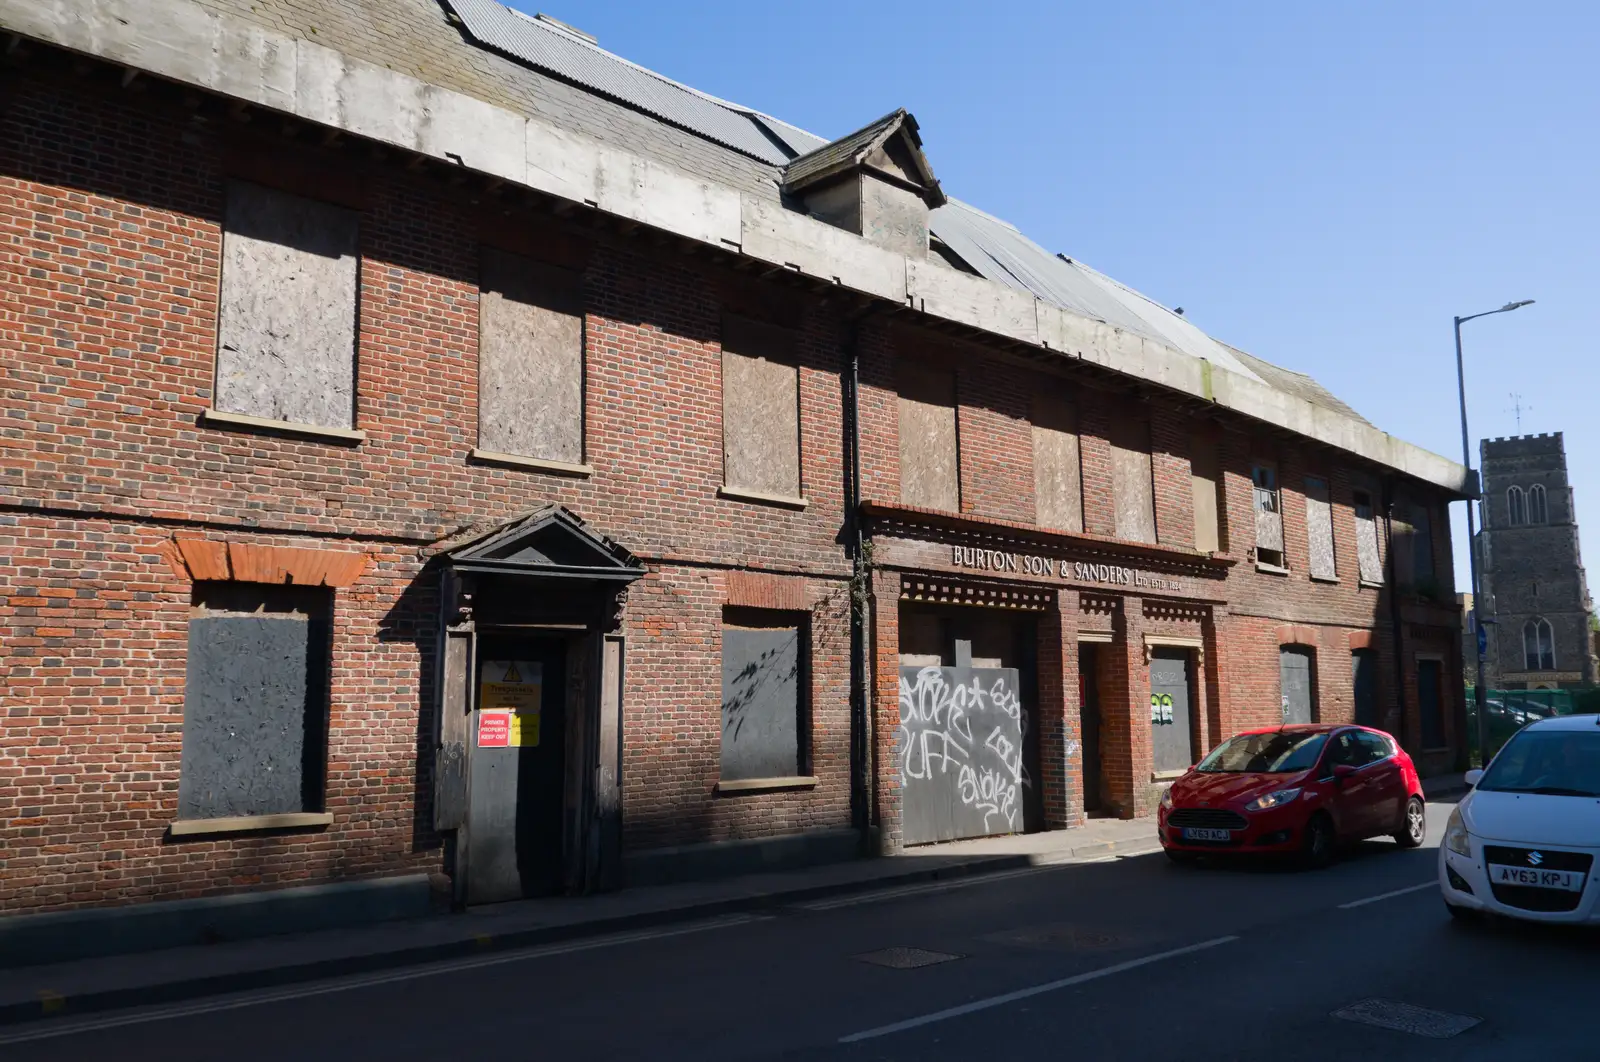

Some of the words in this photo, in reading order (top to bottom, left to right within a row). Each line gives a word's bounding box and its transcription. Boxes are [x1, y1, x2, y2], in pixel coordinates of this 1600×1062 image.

[1023, 555, 1053, 575] SON
[1061, 560, 1069, 577] &
[1075, 561, 1130, 584] SANDERS
[1187, 828, 1209, 839] LY63
[1211, 829, 1229, 840] ACJ
[1502, 868, 1538, 884] AY63
[1541, 872, 1571, 887] KPJ
